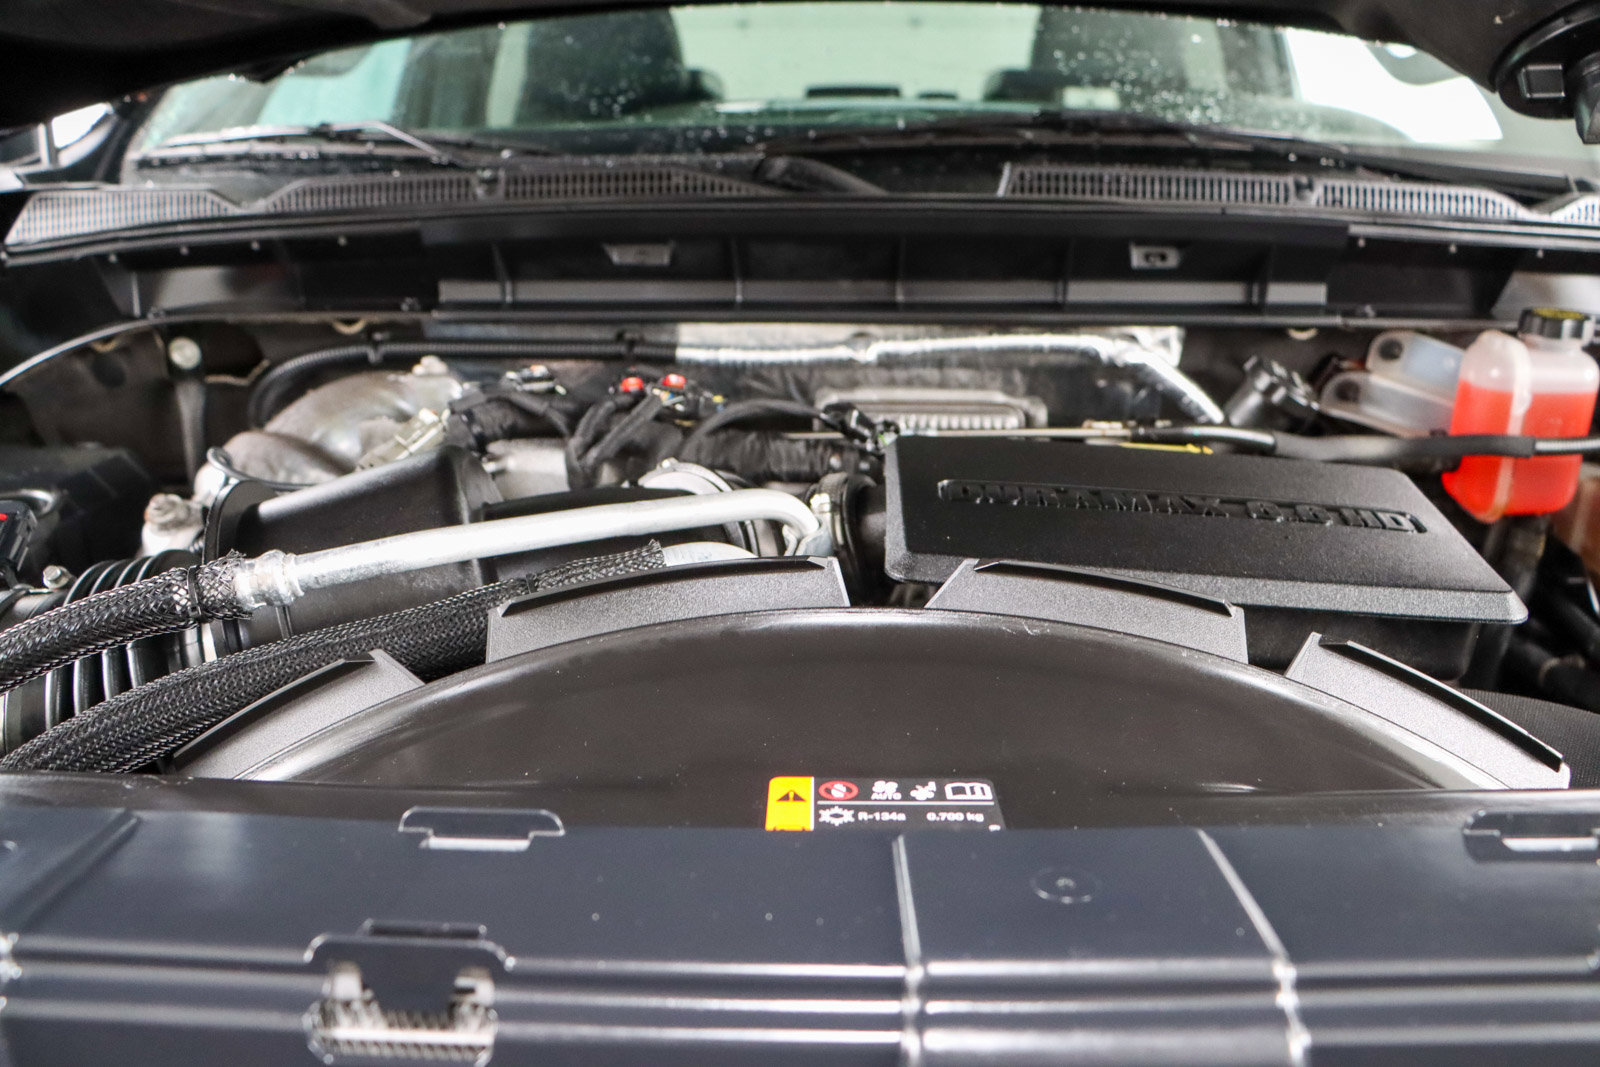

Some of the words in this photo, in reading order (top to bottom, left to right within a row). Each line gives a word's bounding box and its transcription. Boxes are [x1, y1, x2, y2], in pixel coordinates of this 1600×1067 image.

[948, 483, 1229, 517] DURAMAX
[870, 792, 902, 800] AUTO
[857, 811, 907, 822] R-134a
[966, 811, 985, 823] kg
